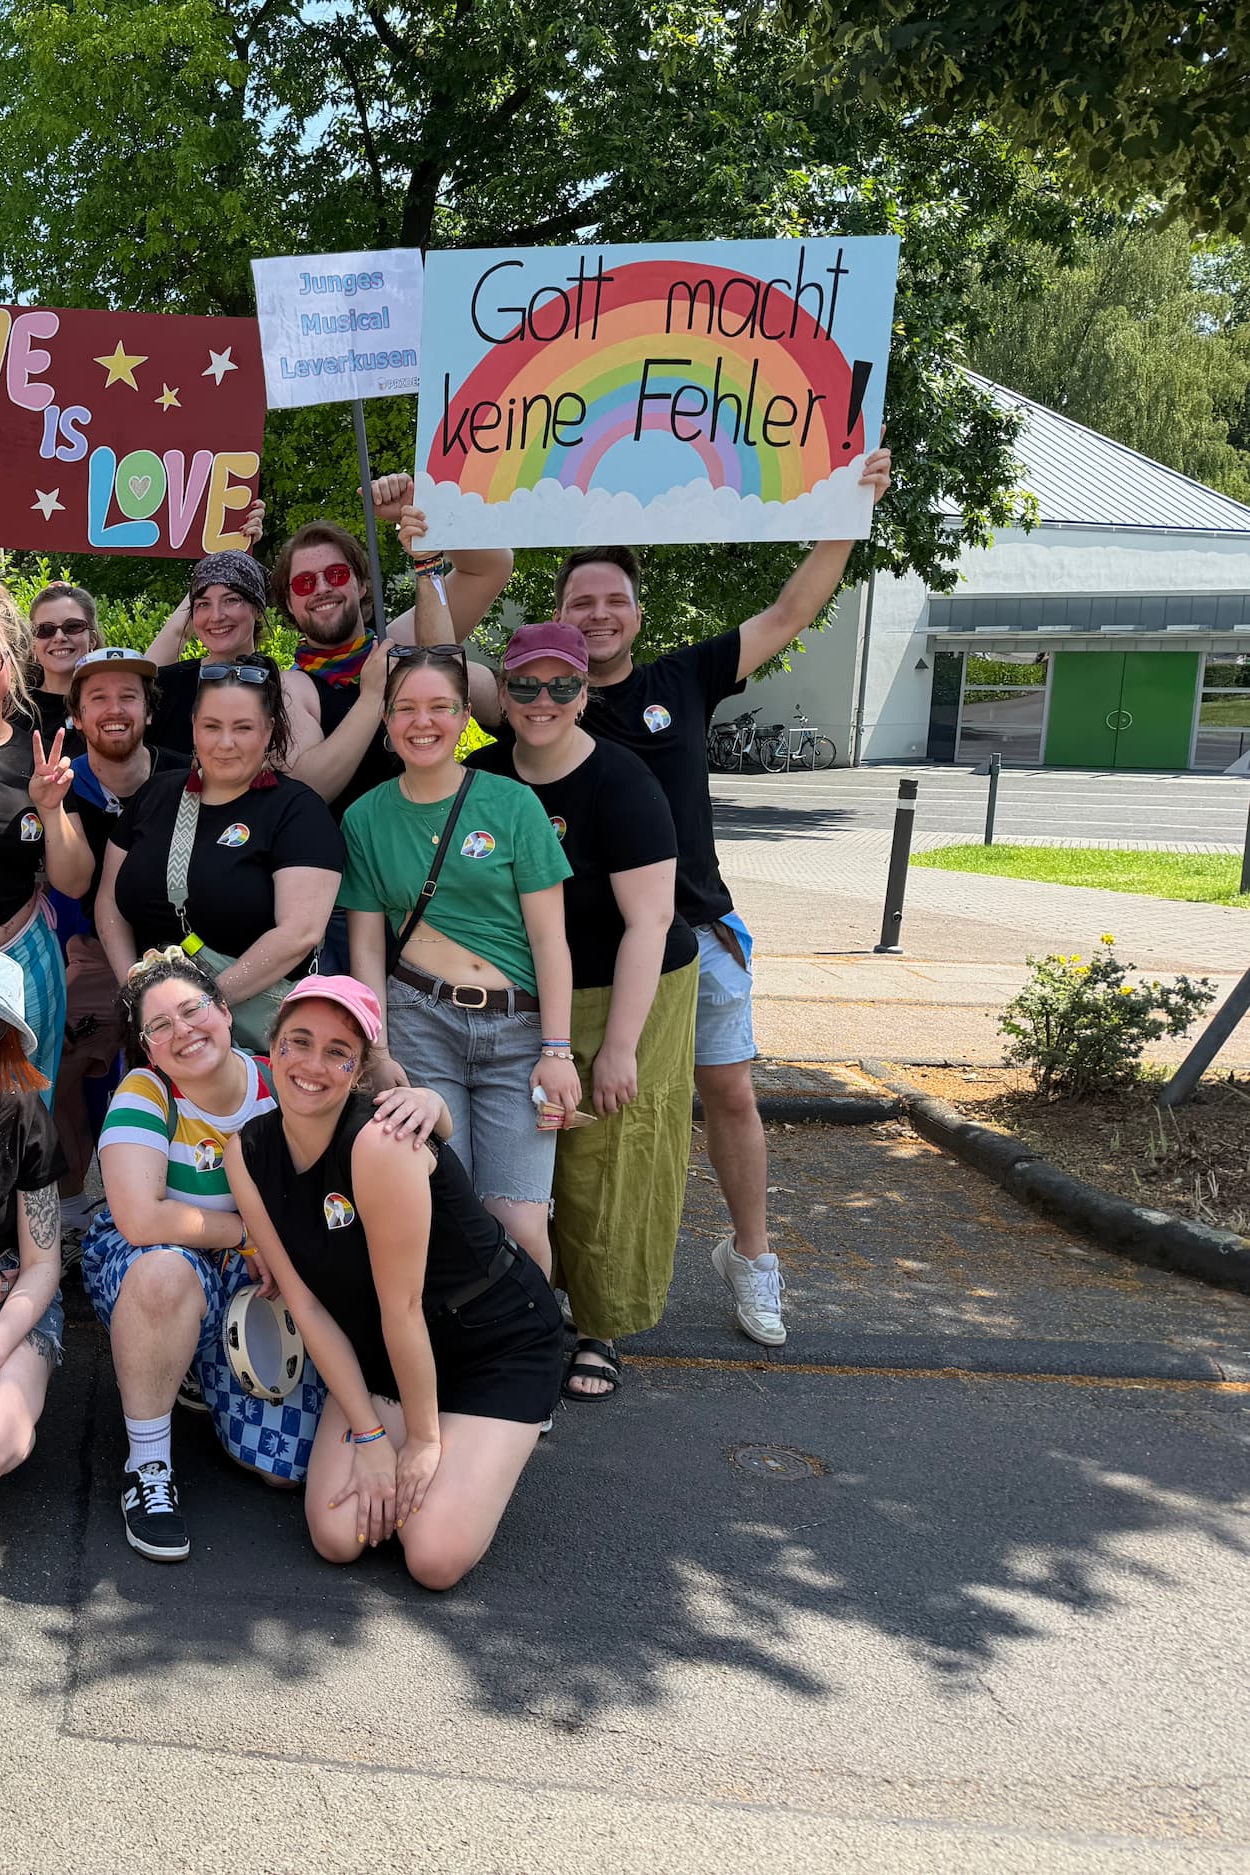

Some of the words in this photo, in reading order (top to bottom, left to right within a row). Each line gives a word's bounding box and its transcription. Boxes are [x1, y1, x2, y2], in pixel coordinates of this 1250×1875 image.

[300, 271, 384, 296] Junges
[470, 254, 615, 345] Gott
[664, 246, 849, 342] macht
[301, 306, 390, 336] Musical
[280, 349, 417, 379] Leverkusen
[39, 404, 92, 462] IS
[442, 371, 587, 457] keine
[88, 446, 260, 554] LOVE
